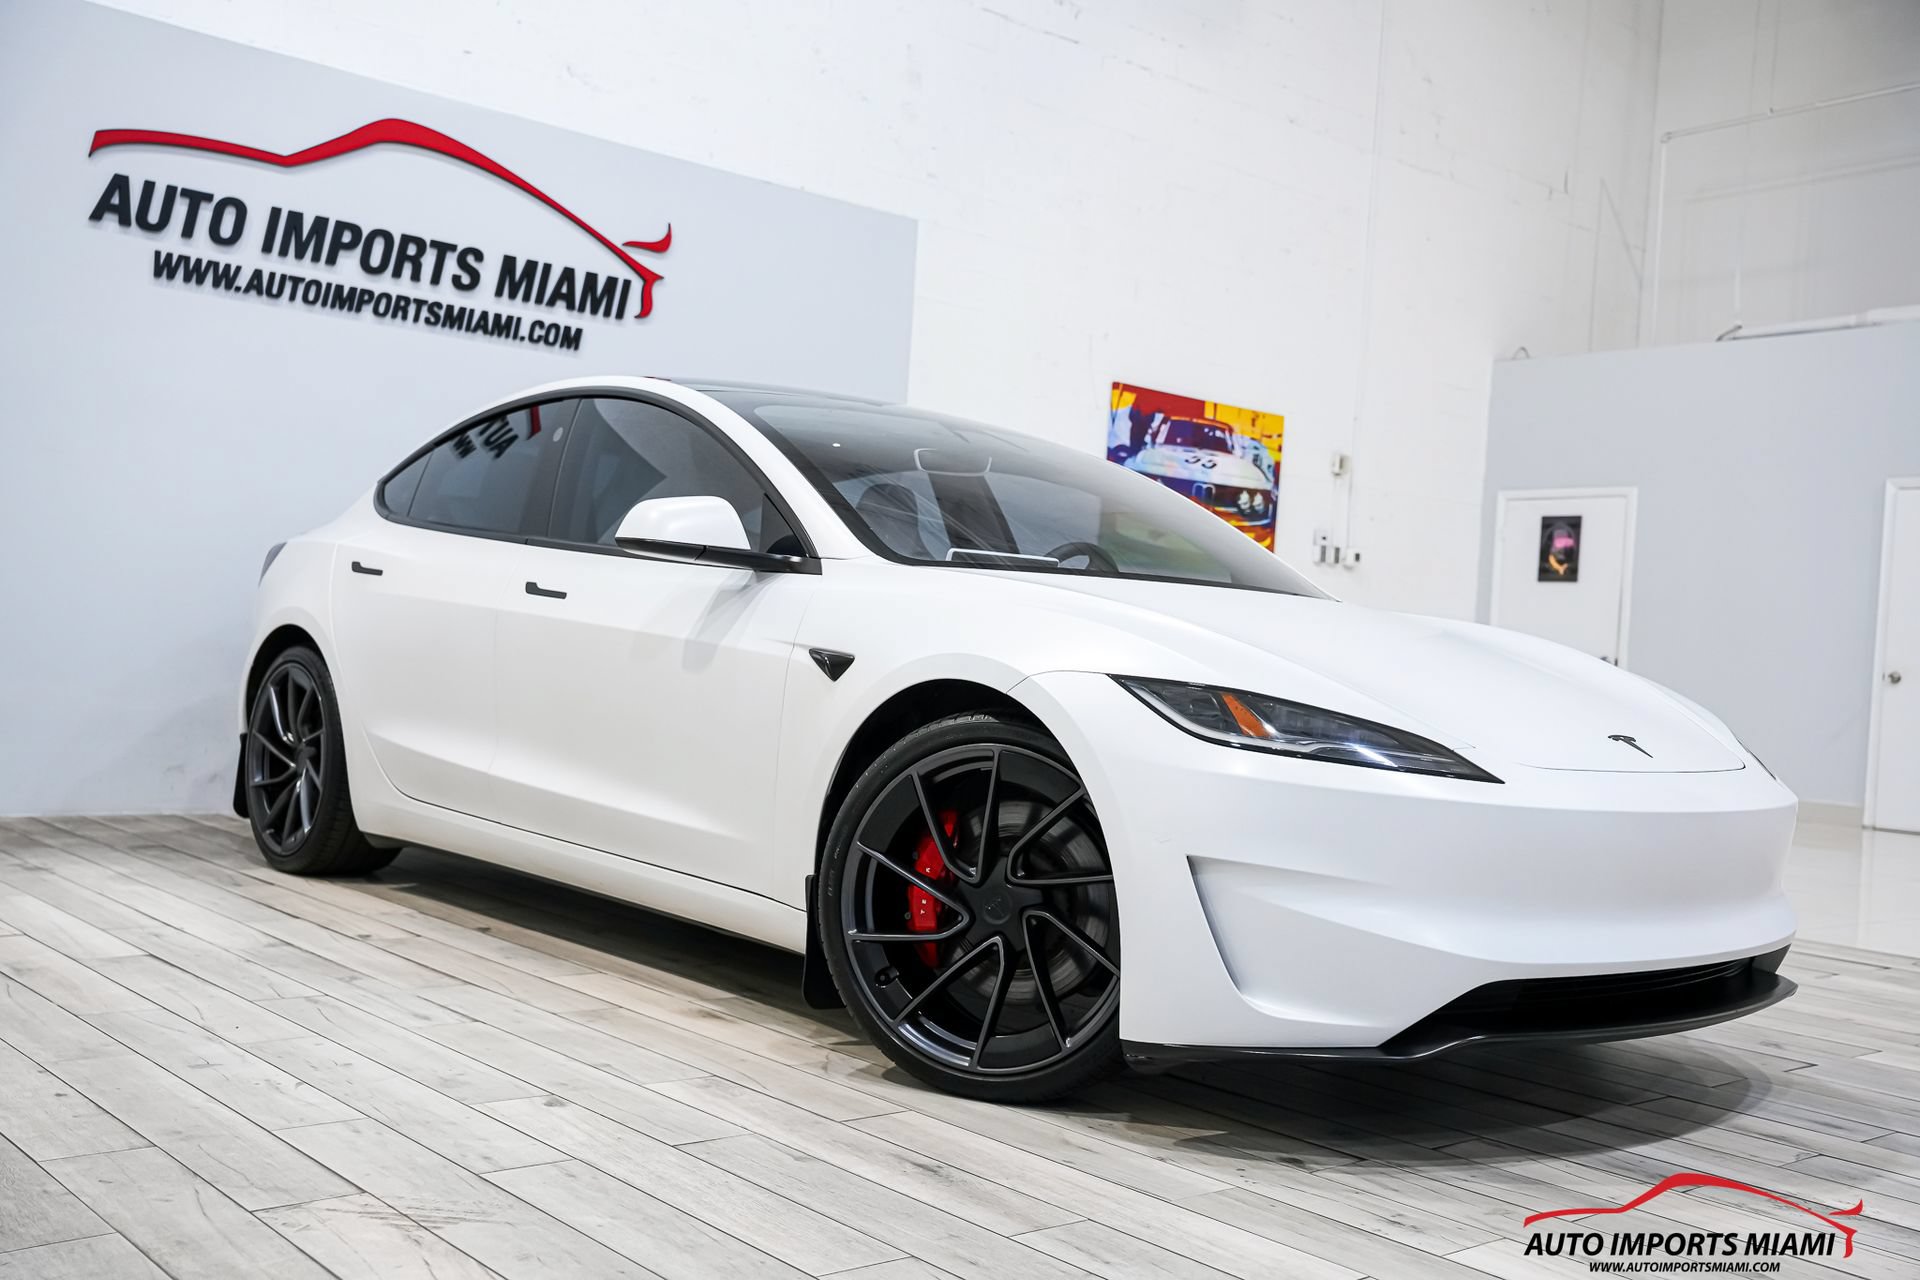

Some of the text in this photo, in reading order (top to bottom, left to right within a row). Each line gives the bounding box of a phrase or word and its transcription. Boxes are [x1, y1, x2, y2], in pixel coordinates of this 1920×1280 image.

[88, 173, 632, 321] AUTO IMPORTS MIAMI
[153, 250, 583, 351] WWW.AUTOIMPORTSMIAMI.COM
